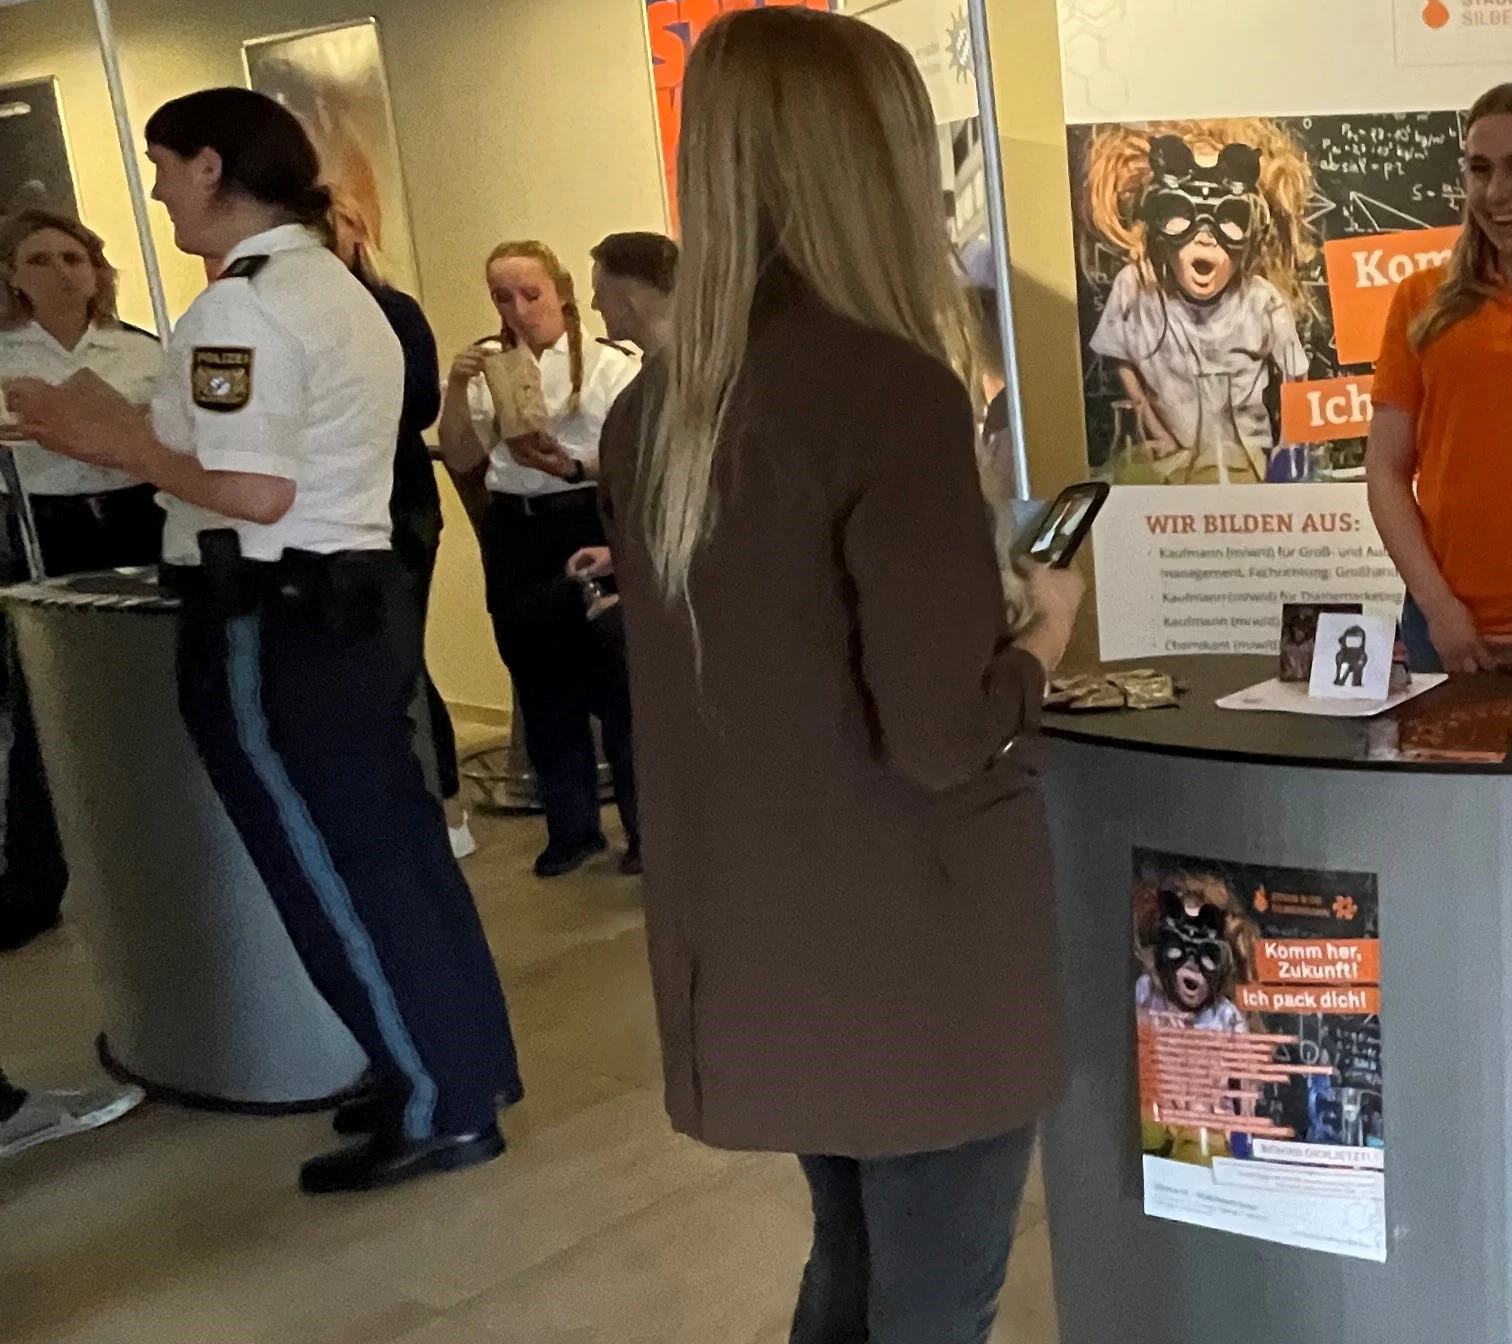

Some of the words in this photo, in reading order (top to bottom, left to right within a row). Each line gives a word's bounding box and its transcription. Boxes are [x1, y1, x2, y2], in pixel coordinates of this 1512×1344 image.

[1306, 383, 1373, 428] Ich
[1144, 513, 1197, 535] WIR
[1203, 512, 1294, 534] BILDEN
[1301, 512, 1361, 534] AUS:
[1264, 942, 1323, 959] Komm
[1326, 942, 1363, 962] her,
[1278, 960, 1358, 979] Zukunft!
[1242, 988, 1270, 1007] Ich
[1273, 990, 1317, 1011] pack
[1320, 990, 1367, 1008] dich!
